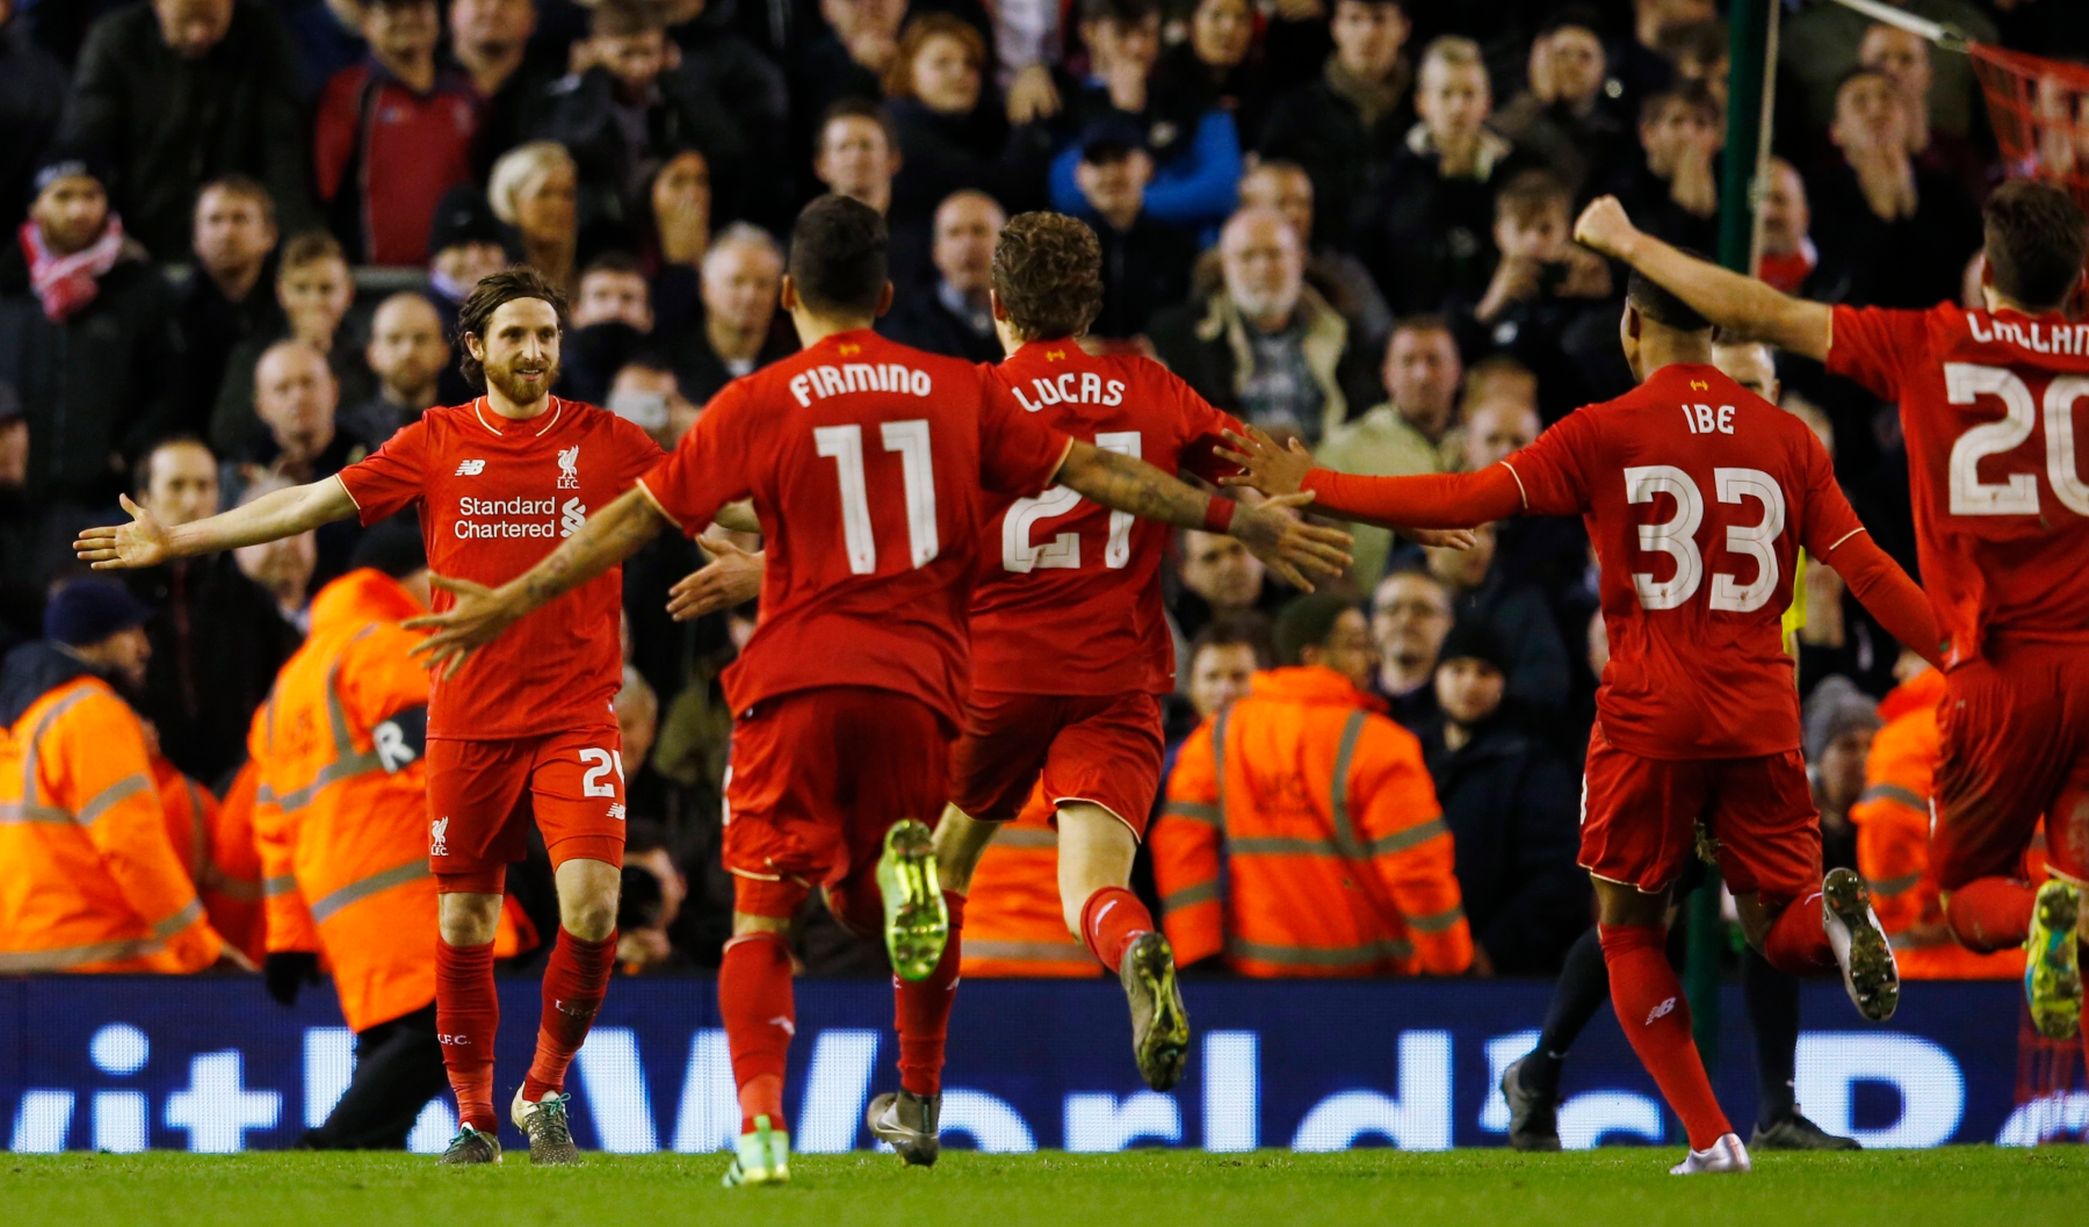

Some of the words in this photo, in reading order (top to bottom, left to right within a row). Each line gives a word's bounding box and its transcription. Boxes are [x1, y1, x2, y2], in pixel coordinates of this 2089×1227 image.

[790, 364, 932, 408] FIRMINO
[1012, 373, 1126, 412] LUCAS
[1681, 404, 1736, 435] IBE
[460, 496, 556, 516] Standard
[813, 419, 939, 575] 11
[1002, 431, 1142, 574] 21
[454, 520, 555, 539] Chartered
[1623, 465, 1786, 613] 33
